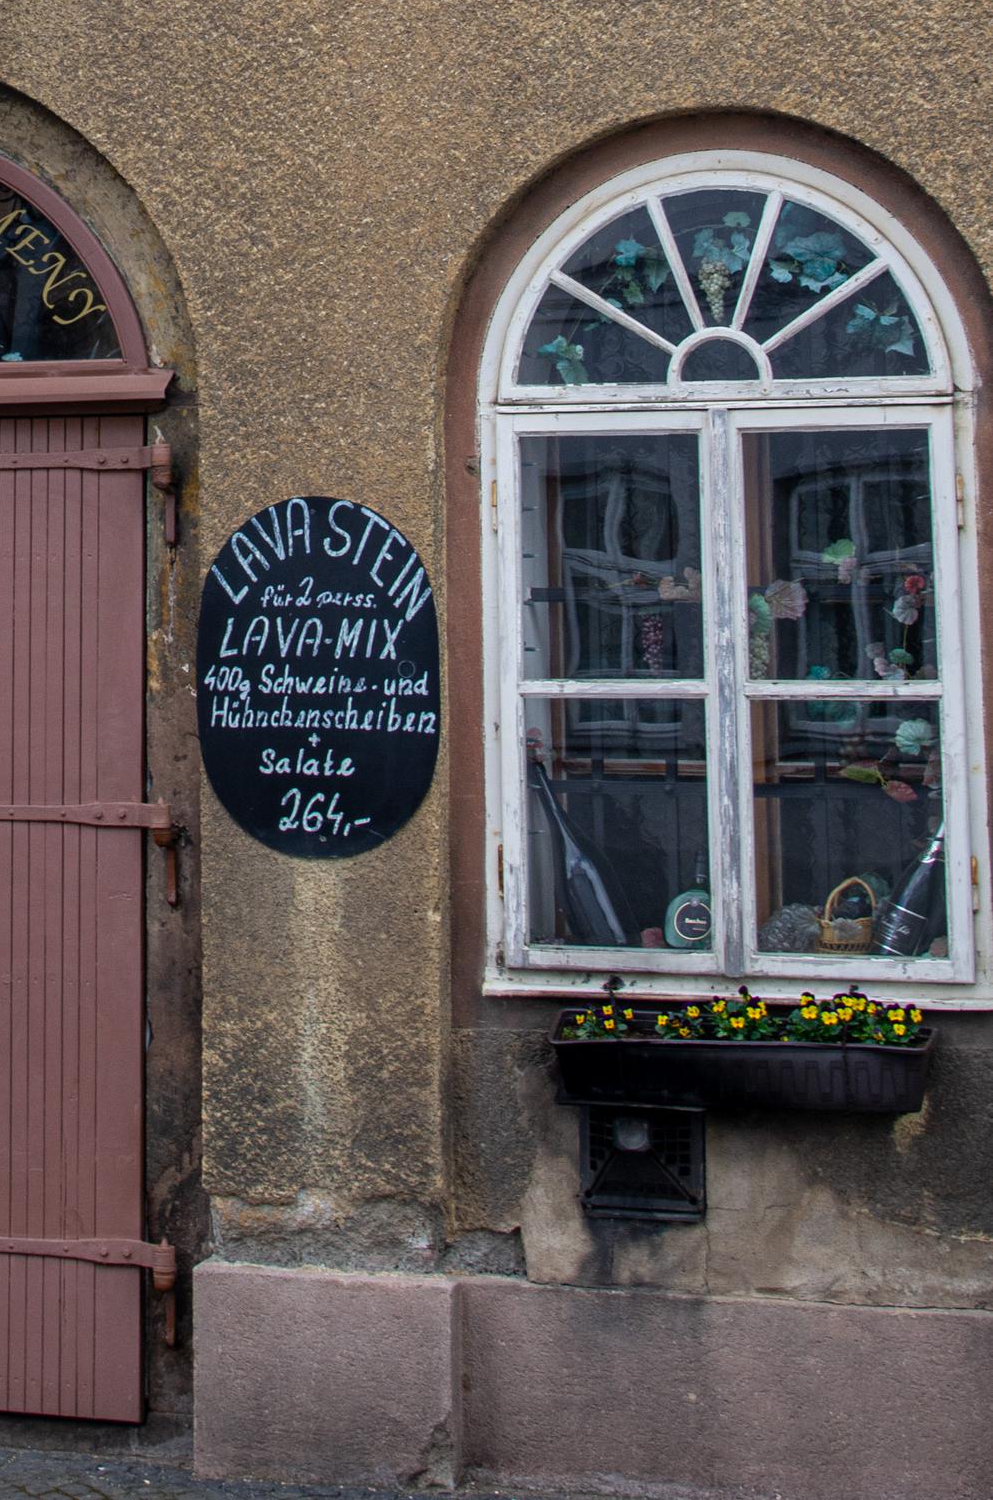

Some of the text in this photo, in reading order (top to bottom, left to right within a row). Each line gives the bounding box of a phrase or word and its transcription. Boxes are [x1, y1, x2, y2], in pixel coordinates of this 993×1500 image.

[211, 498, 433, 622] LAVA STEIN
[295, 576, 314, 607] 2
[219, 615, 405, 660] LAVA-MIX
[203, 664, 251, 700] 400g
[383, 670, 429, 696] und
[211, 696, 437, 735] Hühnchenscheiben
[259, 748, 355, 777] Salate
